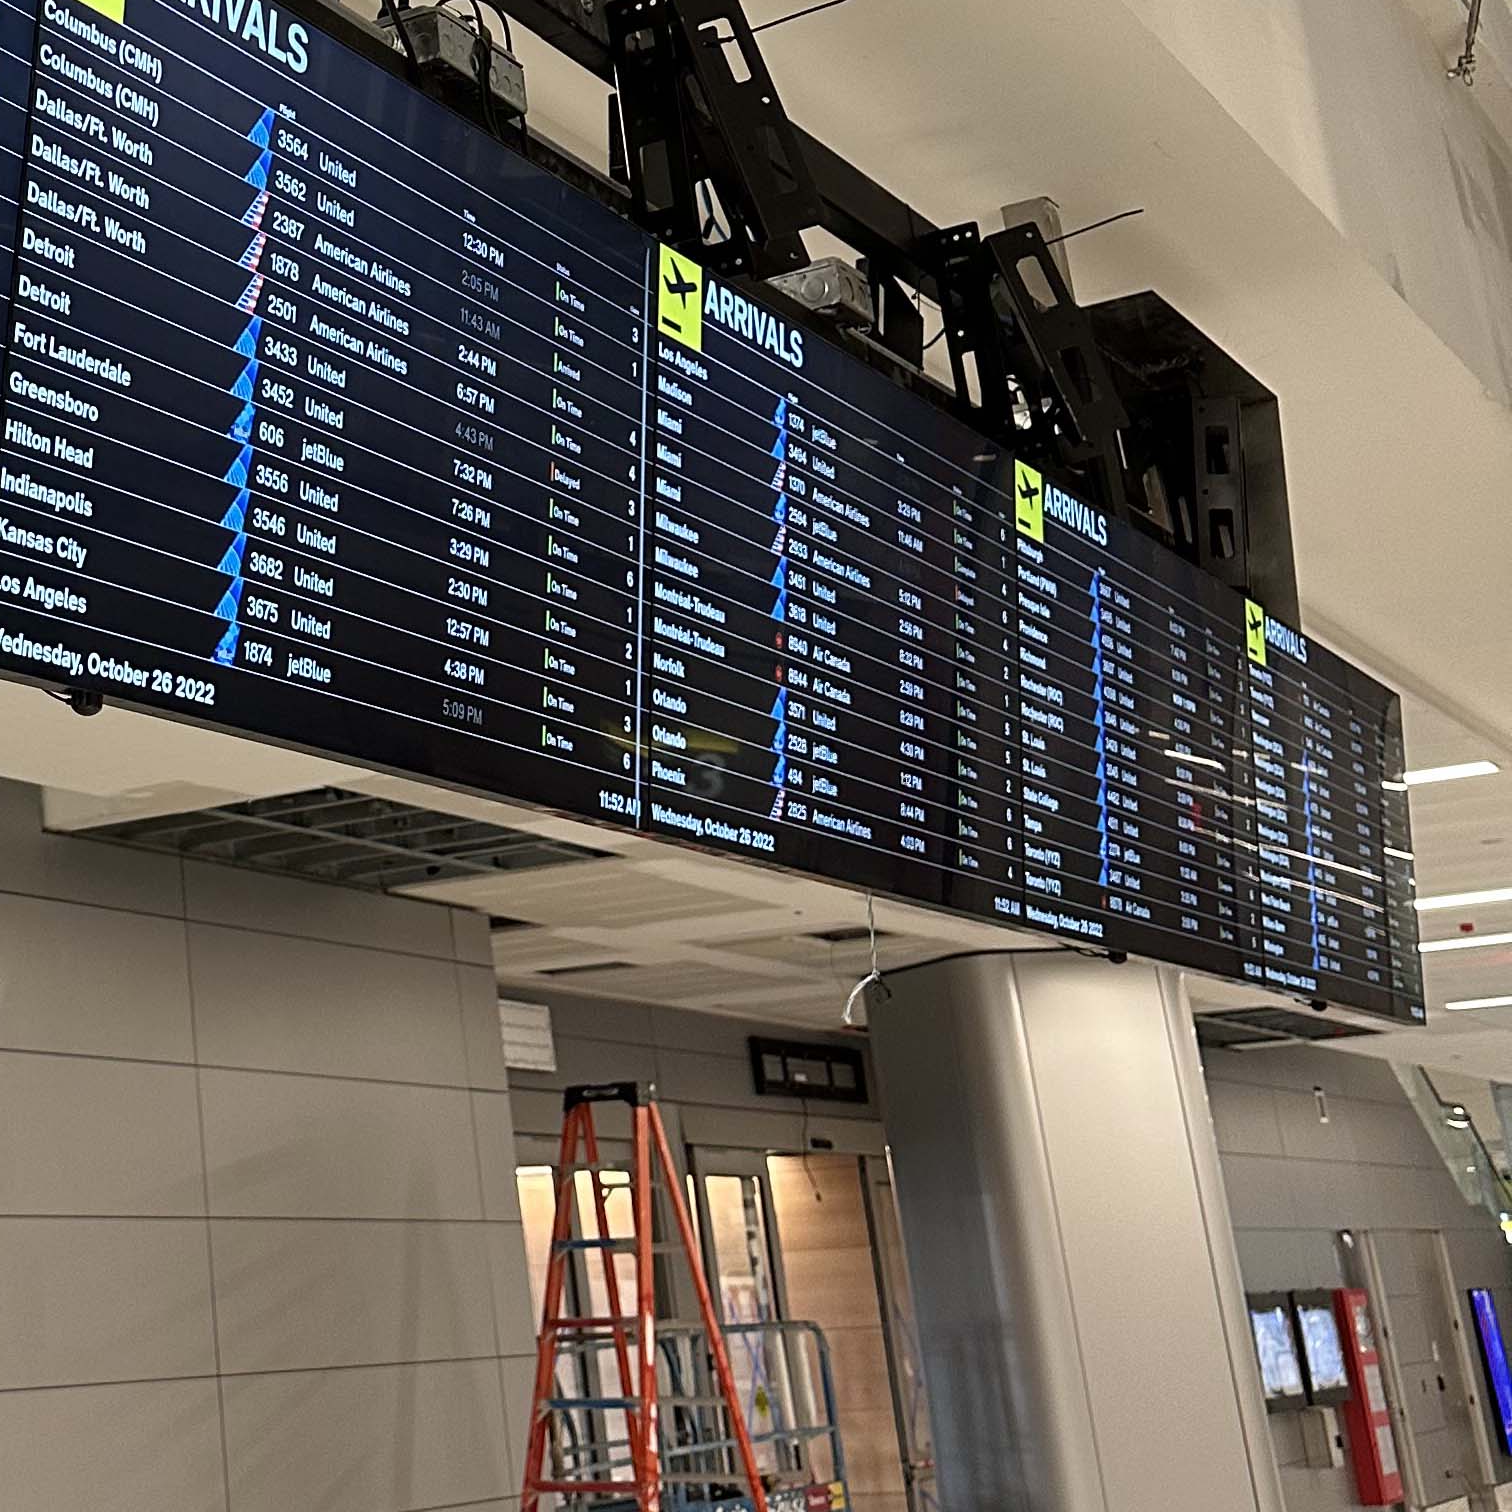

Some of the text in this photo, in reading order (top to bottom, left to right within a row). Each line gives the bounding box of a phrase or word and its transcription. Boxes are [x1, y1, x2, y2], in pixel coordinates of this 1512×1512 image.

[118, 39, 163, 85] (CMH)
[39, 43, 159, 128] Columbus (CMH)
[34, 87, 153, 166] Dallas/Ft. Worth
[277, 128, 309, 161] 3564
[31, 133, 150, 210] Dallas/Ft. Worth
[274, 169, 307, 202] 3562
[318, 151, 357, 188] United
[26, 179, 146, 255] Dallas/Ft. Worth
[272, 210, 305, 241] 2387
[21, 226, 75, 269] Detroit
[313, 233, 411, 297] American Airlines
[462, 232, 504, 268] 12:30 PM
[269, 252, 299, 282] 1878
[17, 274, 71, 316] Detroit
[267, 293, 297, 324] 2501
[703, 279, 803, 368] ARRIVALS
[13, 321, 131, 387] Fort Lauderdale
[263, 335, 298, 367] 3433
[658, 341, 708, 381] Los Angeles
[8, 370, 99, 422] Greensboro
[261, 378, 294, 409] 3452
[4, 417, 94, 469] Hilton Head
[258, 421, 284, 448] 606
[300, 437, 344, 472] jetBlue
[0, 466, 93, 517] Indianapolis
[255, 463, 289, 494] 3556
[251, 507, 286, 537] 3546
[1044, 483, 1109, 547] ARRIVALS
[55, 535, 87, 569] City
[249, 551, 284, 581] 3682
[22, 575, 87, 614] Angeles
[245, 595, 279, 624] 3675
[243, 639, 273, 667] 1874
[1264, 616, 1308, 663] ARRIVALS
[86, 651, 150, 688] October
[150, 668, 173, 694] 26
[174, 675, 215, 706] 2022
[652, 687, 687, 714] Orlando
[598, 789, 622, 813] 11:52
[650, 802, 775, 852] Wednesday, October 26 2022
